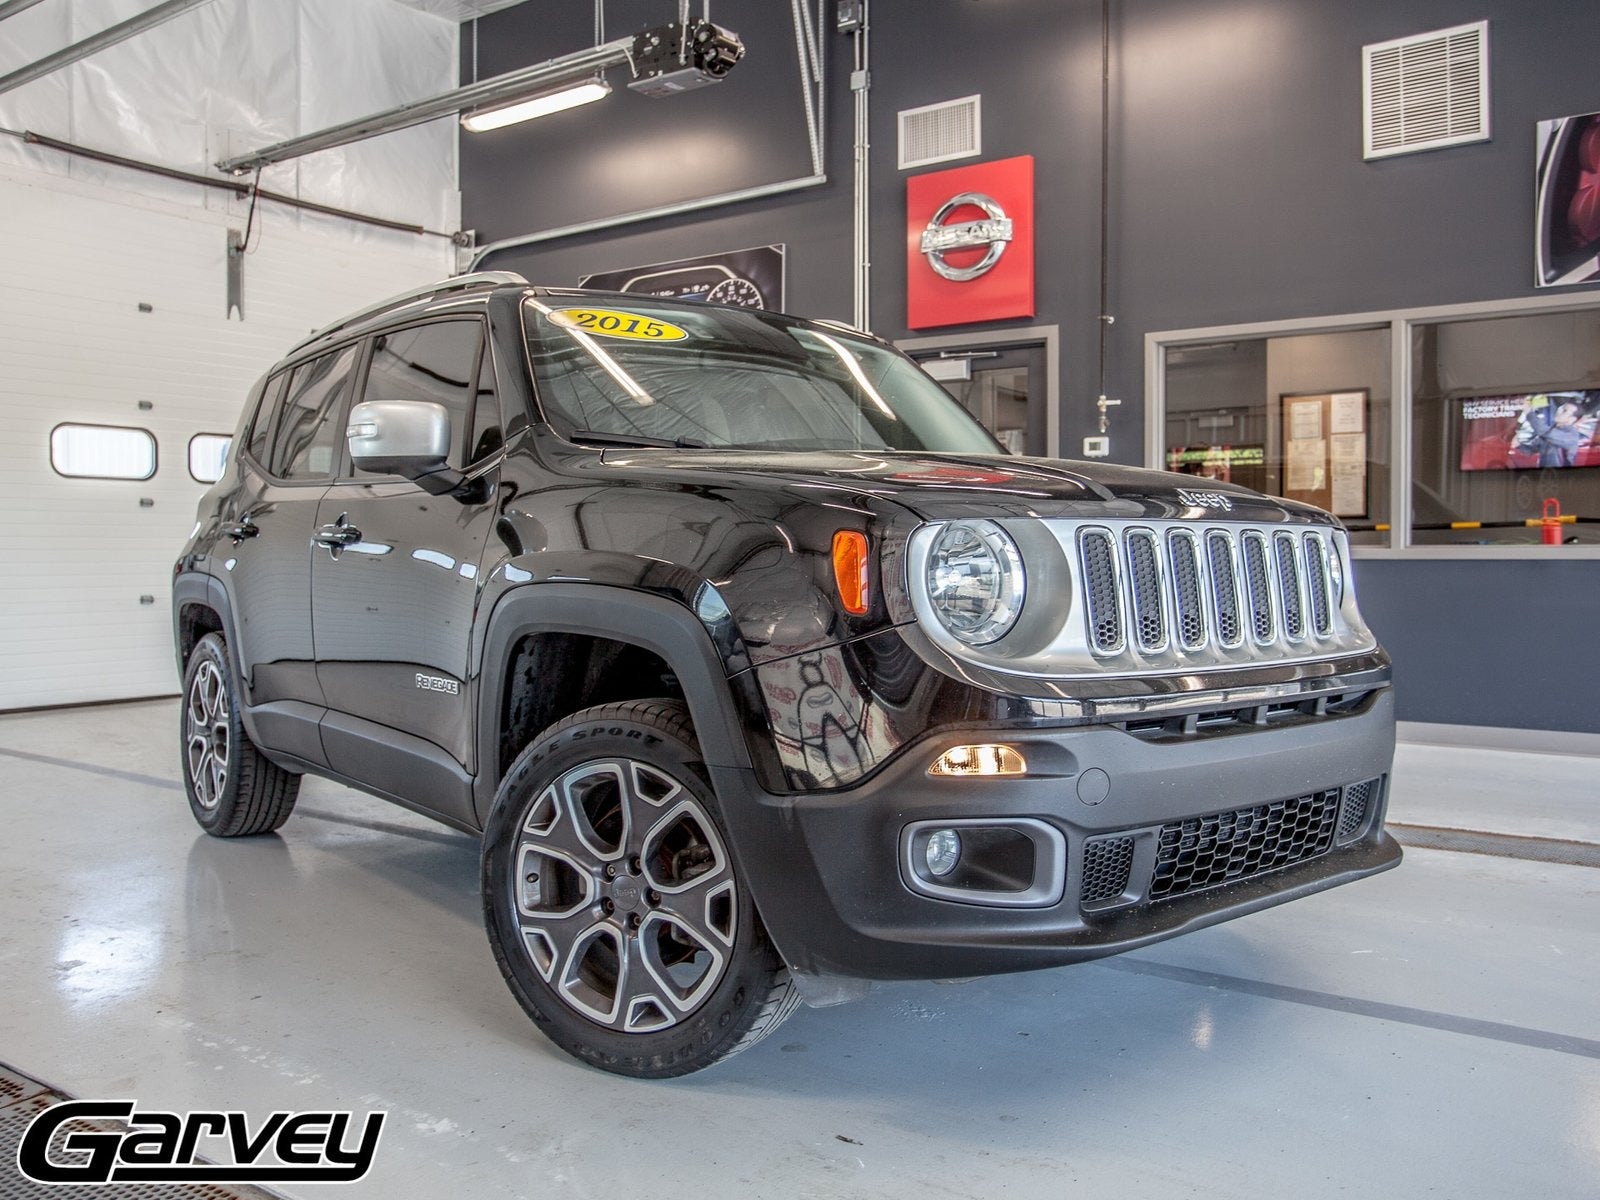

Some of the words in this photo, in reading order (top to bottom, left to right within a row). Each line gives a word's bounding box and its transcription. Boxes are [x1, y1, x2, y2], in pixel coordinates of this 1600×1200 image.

[576, 313, 664, 337] 2015
[1176, 488, 1232, 511] Jeep
[415, 673, 459, 695] RENEGADE
[572, 727, 663, 748] SPORT
